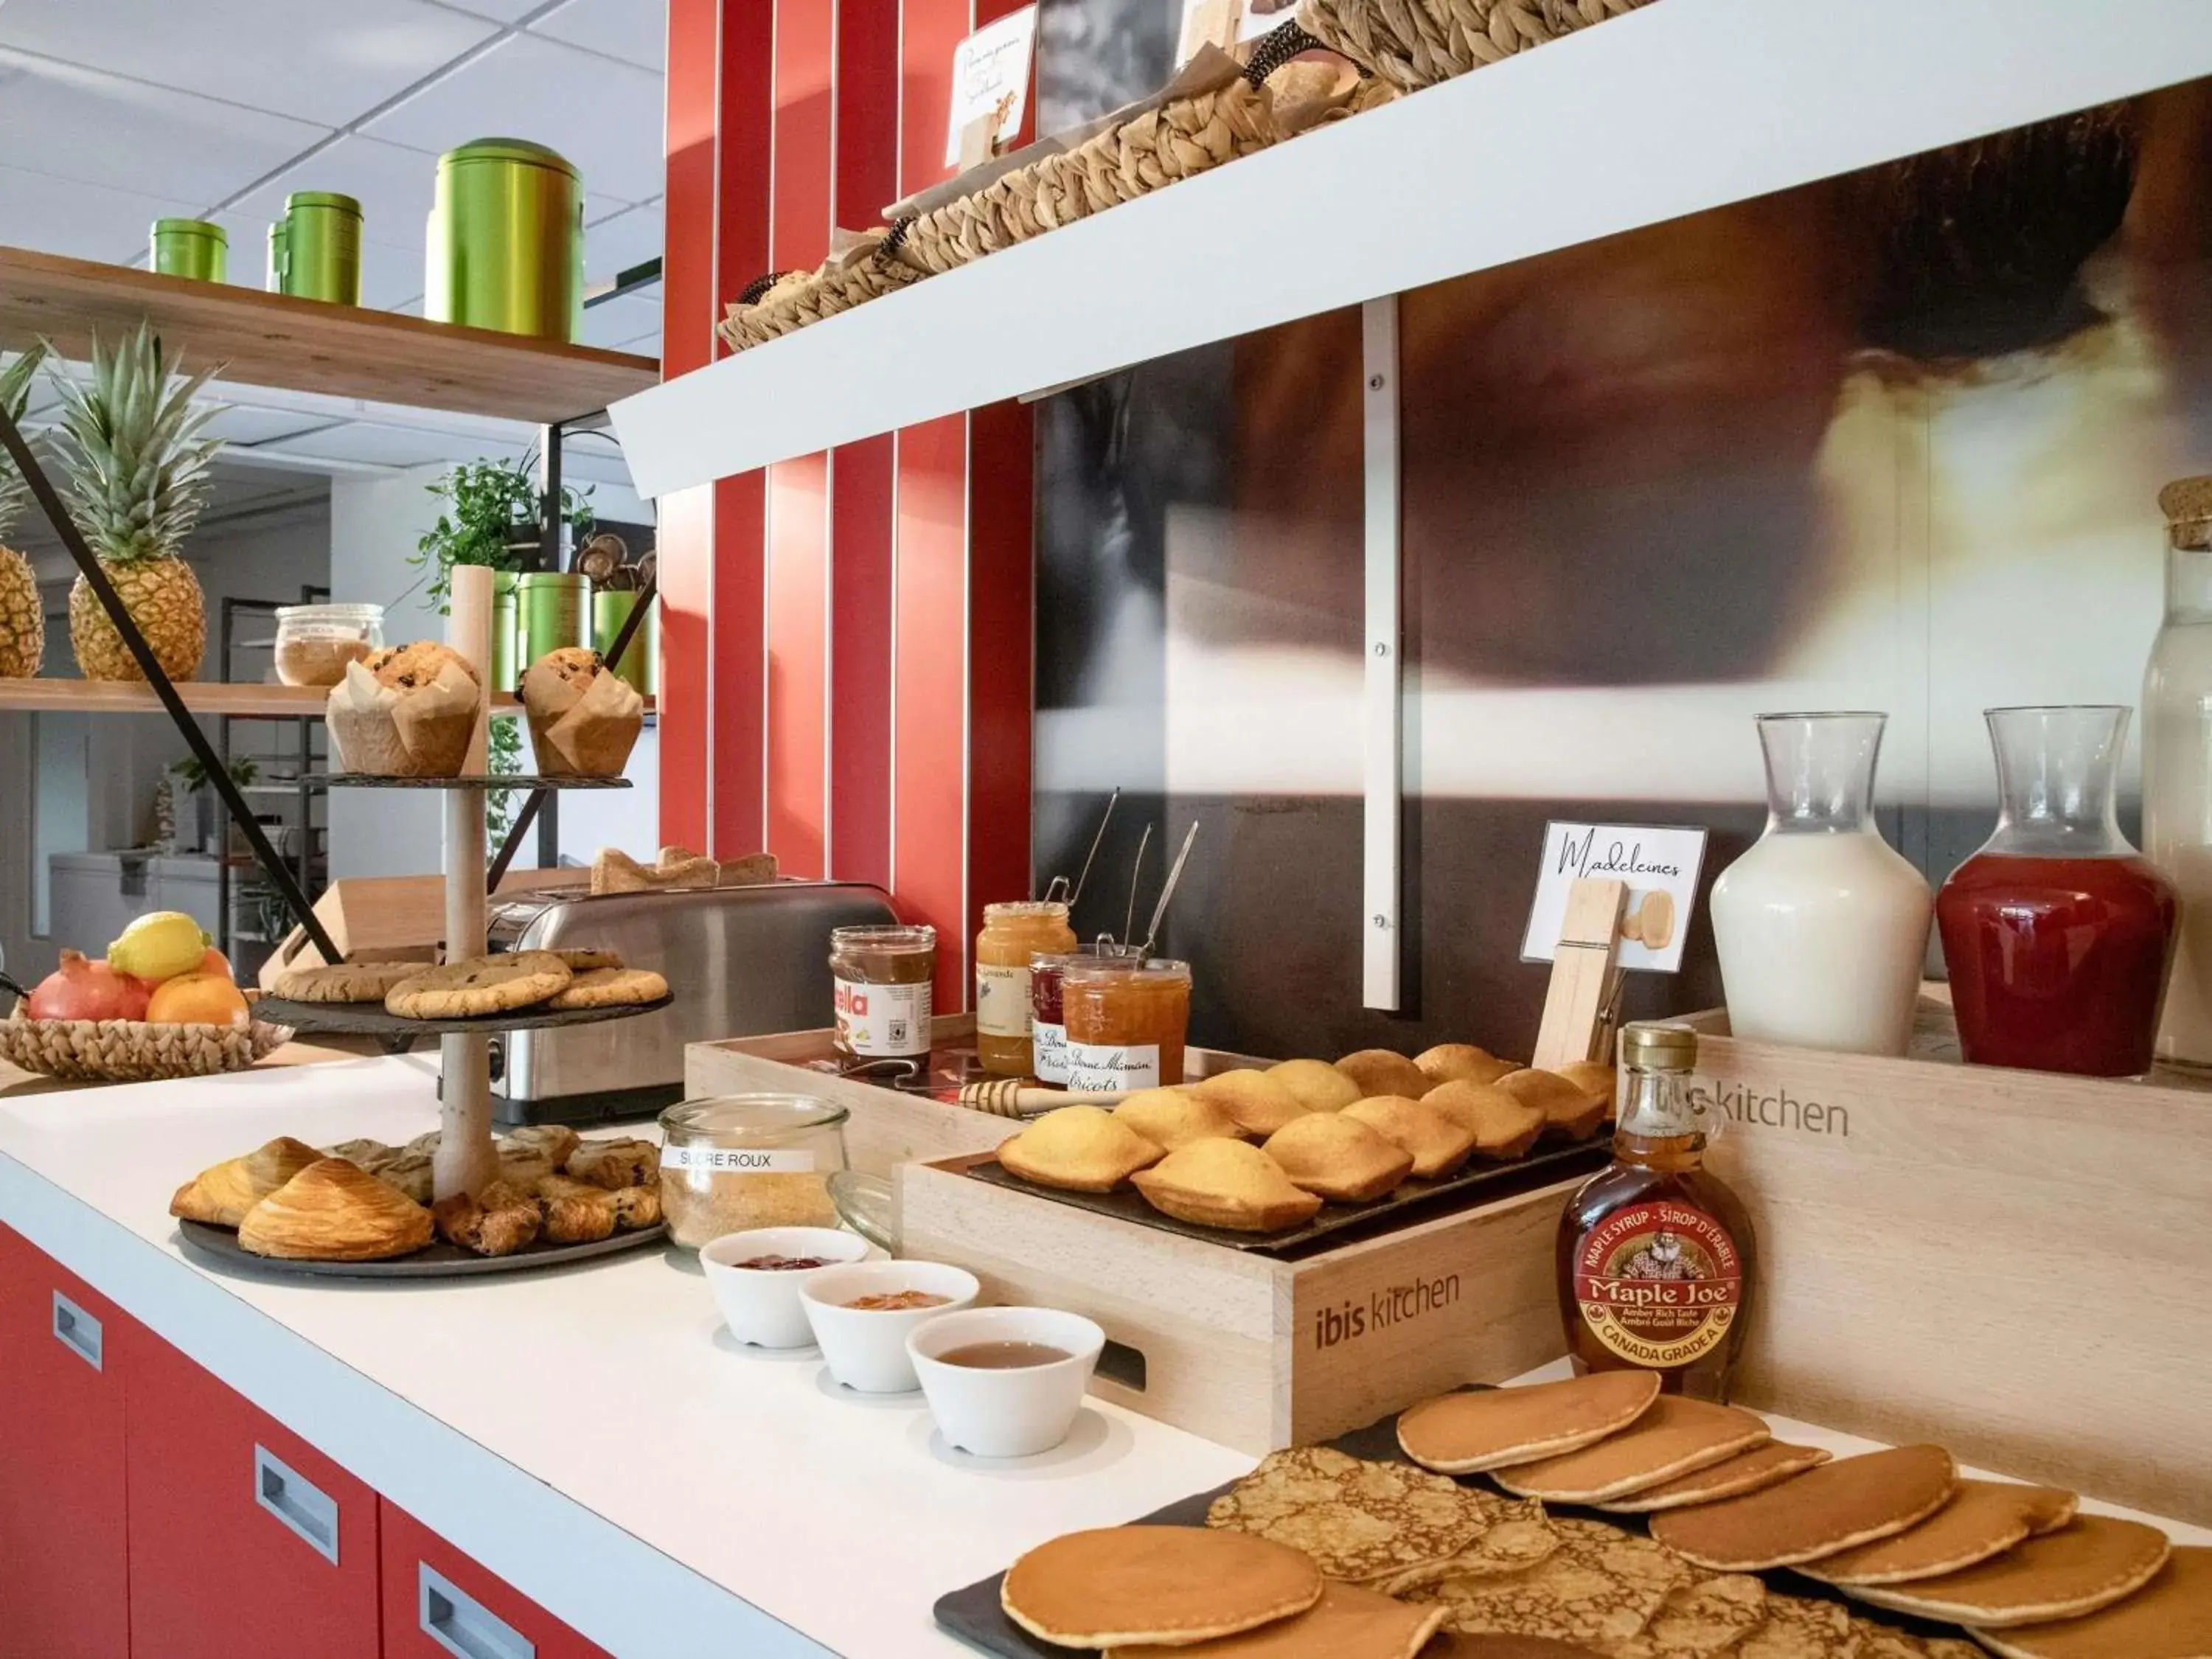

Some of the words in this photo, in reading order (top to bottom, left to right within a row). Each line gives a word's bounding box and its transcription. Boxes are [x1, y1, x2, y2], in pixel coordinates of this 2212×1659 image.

[1558, 827, 1682, 878] Madeleines
[1069, 1071, 1118, 1092] bricots
[1716, 1079, 1849, 1137] kitchen
[728, 1153, 772, 1167] ROUX
[1585, 1229, 1614, 1268] MAPLE
[1610, 1211, 1649, 1236] SYRUP
[1659, 1208, 1697, 1227] SIROP
[1316, 1300, 1366, 1350] ibis
[1371, 1274, 1459, 1332] kitchen
[1588, 1278, 1677, 1307] Maple
[1602, 1325, 1660, 1361] CANADA
[1661, 1336, 1709, 1361] GRADE
[1706, 1328, 1719, 1340] A
